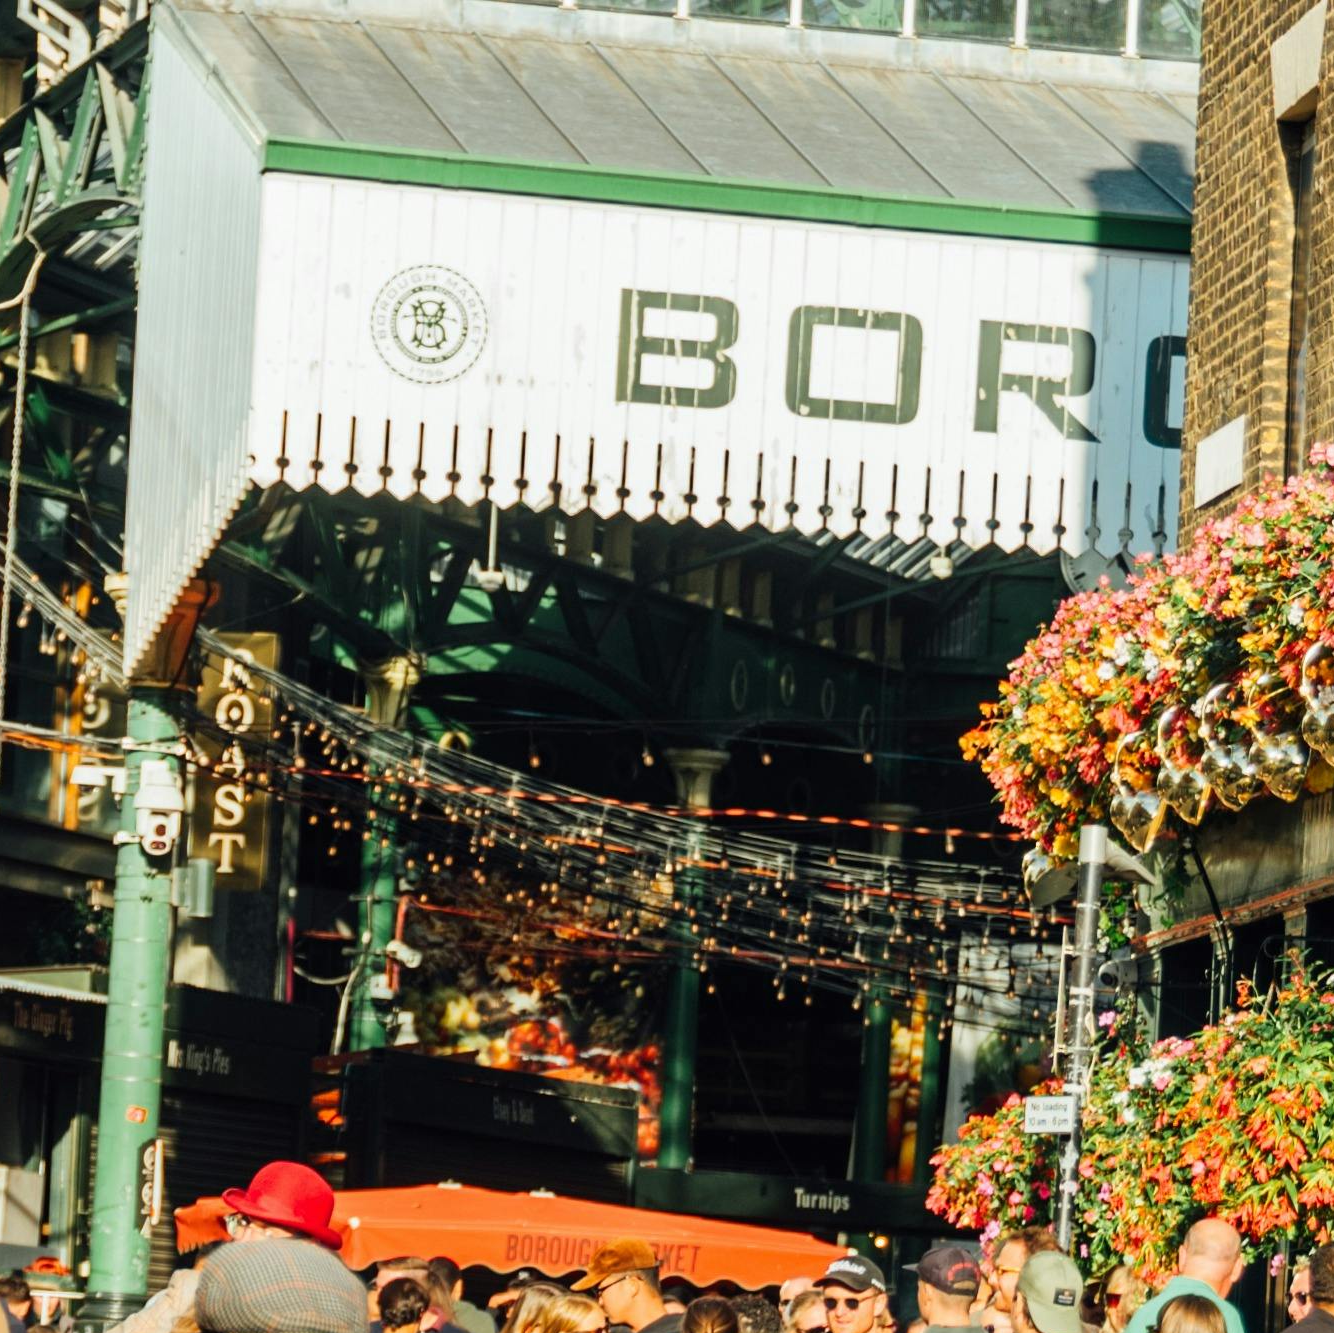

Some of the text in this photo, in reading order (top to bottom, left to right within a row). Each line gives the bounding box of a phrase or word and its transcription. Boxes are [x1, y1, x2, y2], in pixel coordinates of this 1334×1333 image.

[208, 648, 255, 874] ROAST
[1031, 1102, 1041, 1111] No
[794, 1187, 850, 1213] Turnips
